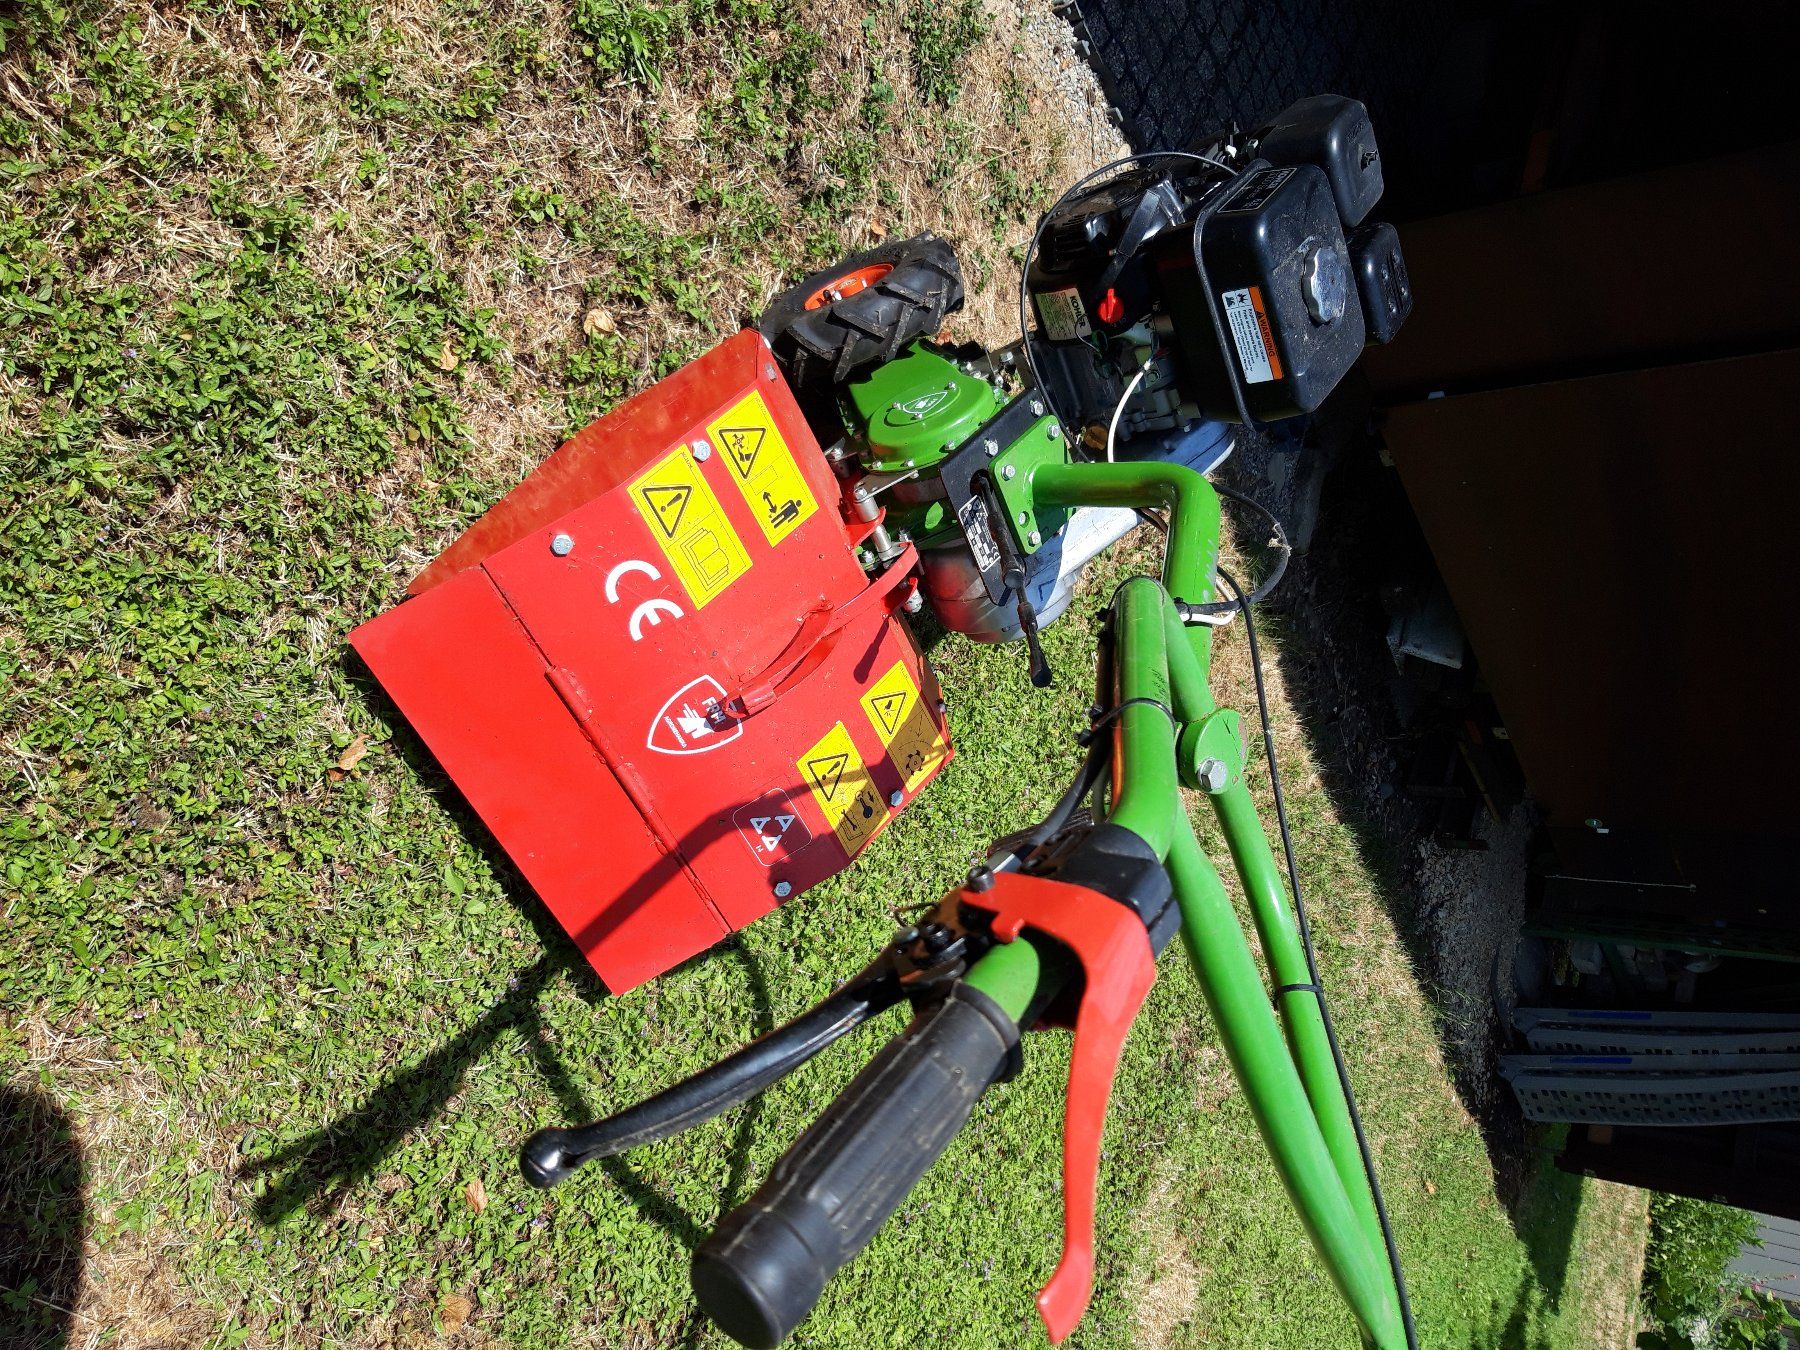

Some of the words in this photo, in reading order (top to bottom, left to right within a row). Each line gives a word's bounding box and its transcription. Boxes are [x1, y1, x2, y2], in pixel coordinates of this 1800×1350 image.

[1070, 295, 1086, 328] KOHLER
[1260, 318, 1275, 357] WARNING
[605, 559, 685, 642] CE
